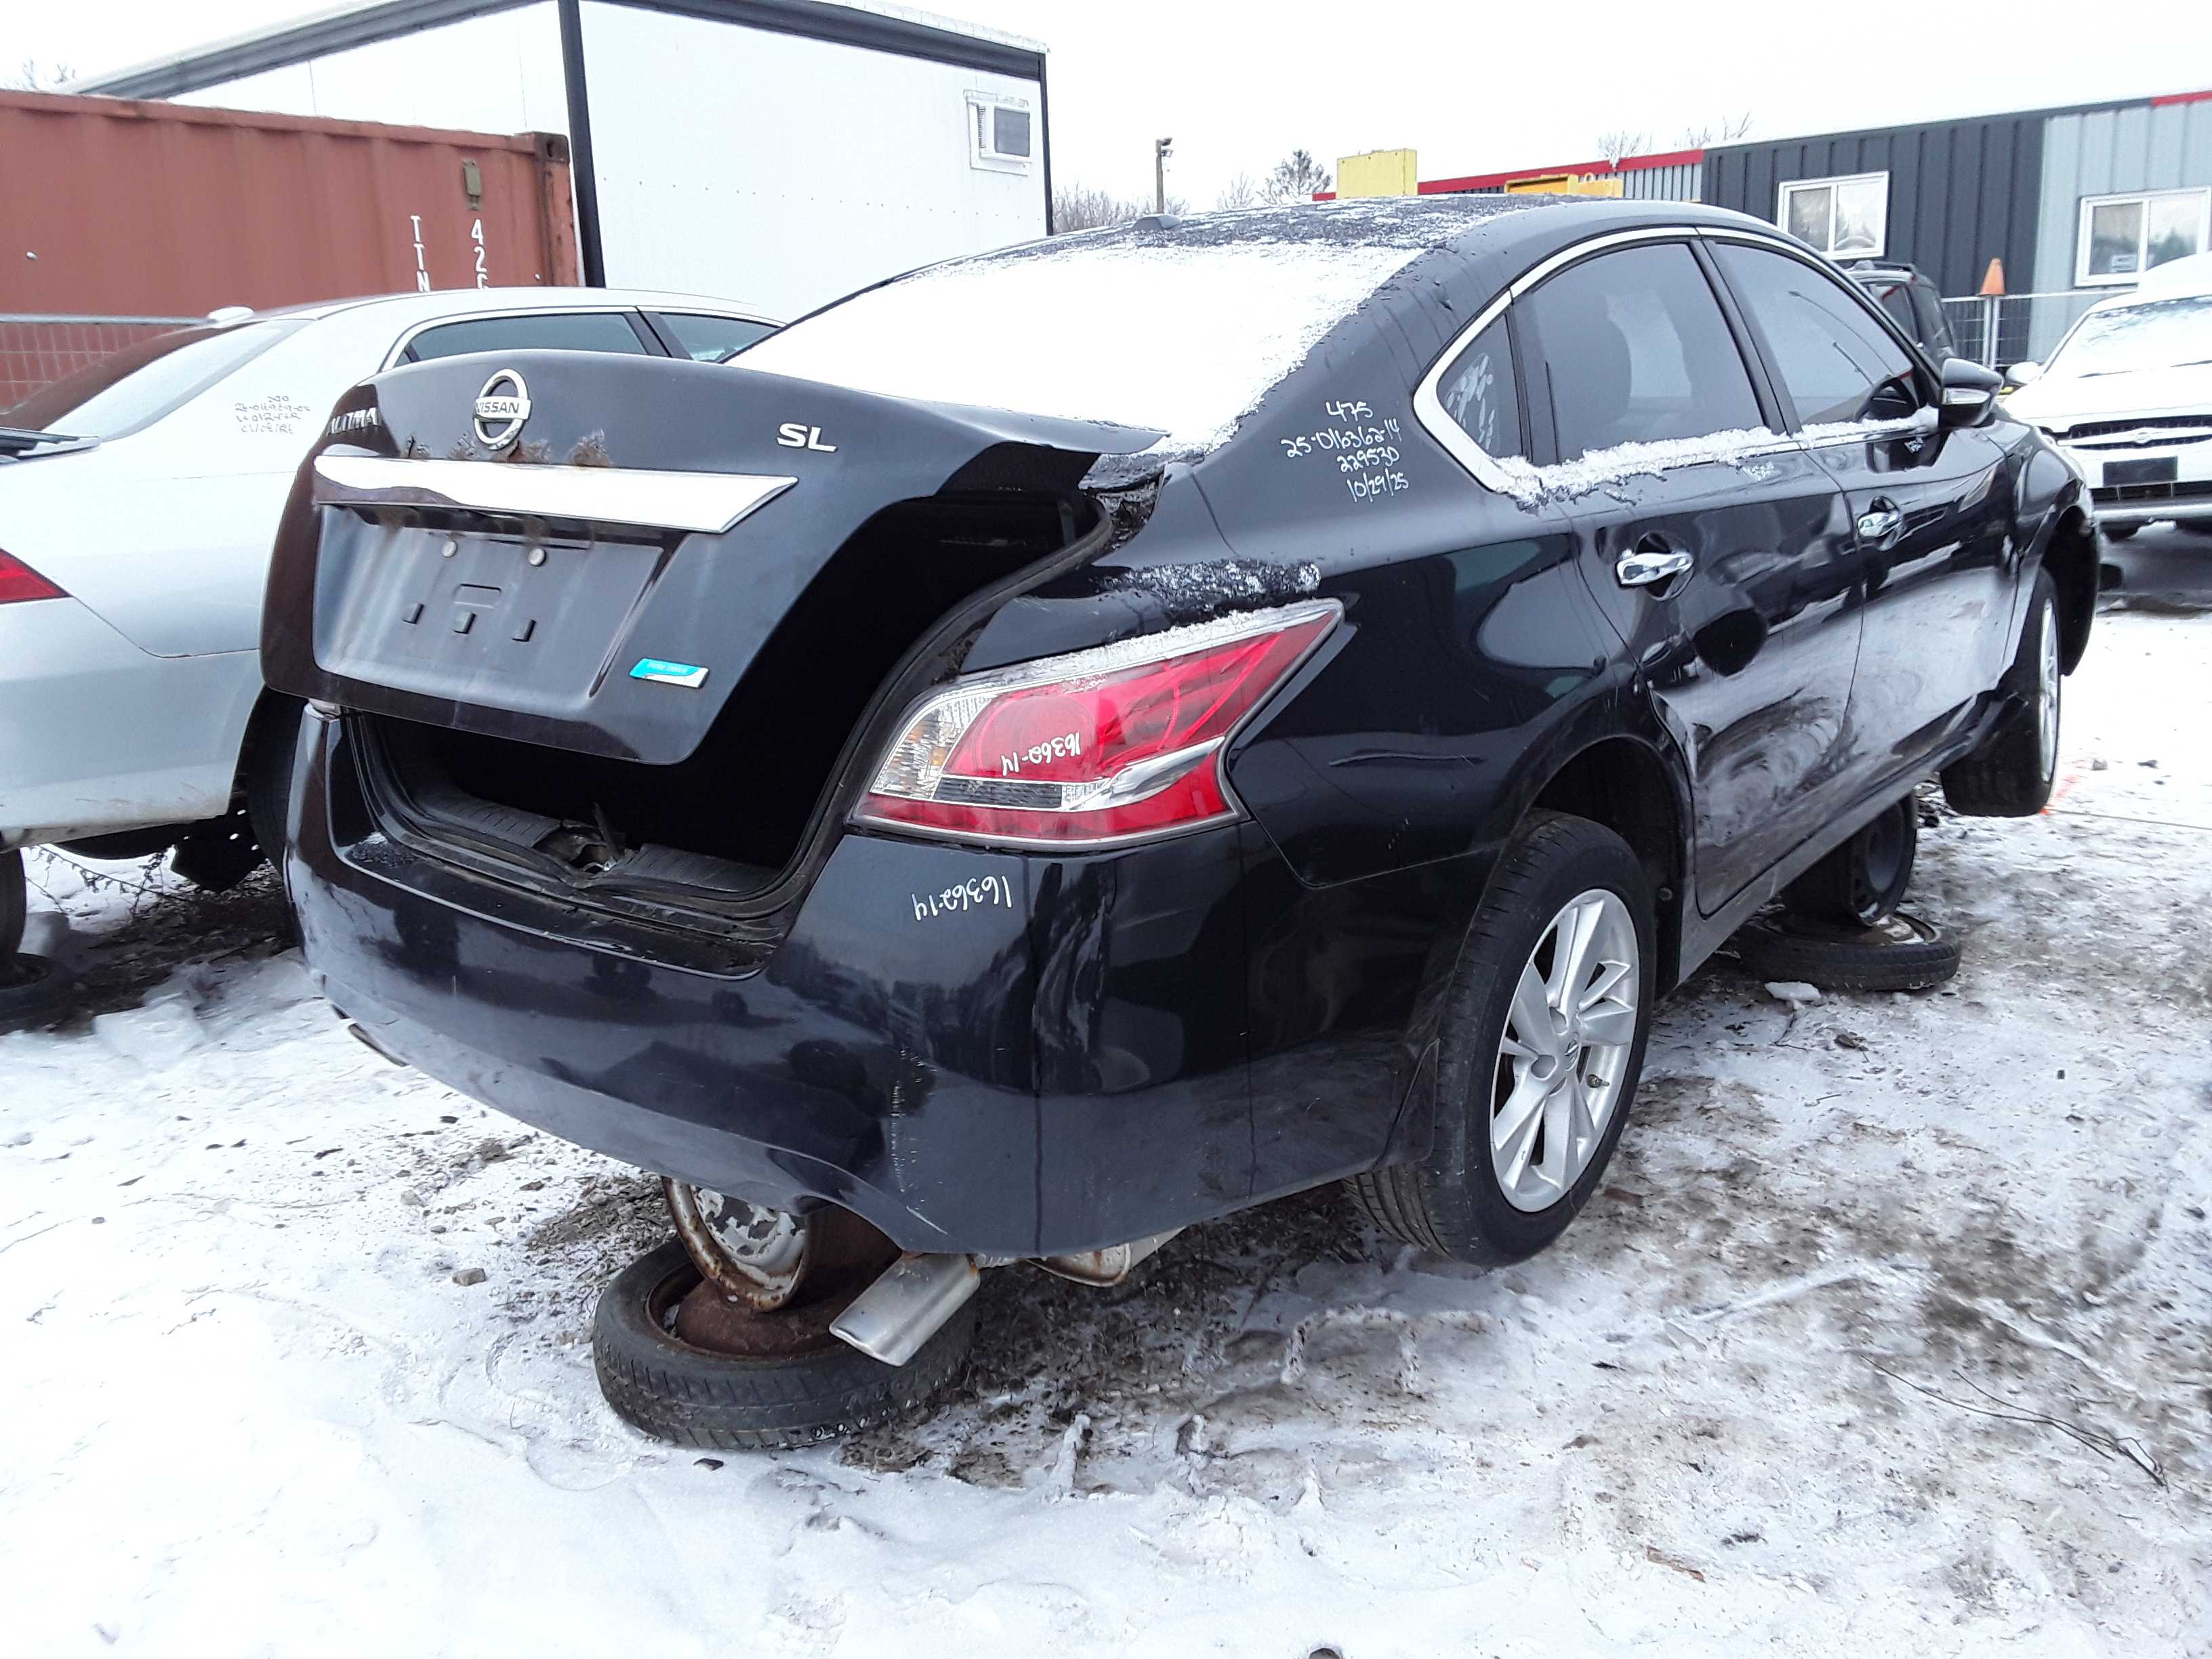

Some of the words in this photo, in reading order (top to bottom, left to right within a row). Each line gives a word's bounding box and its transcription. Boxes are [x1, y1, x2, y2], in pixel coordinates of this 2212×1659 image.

[476, 401, 520, 413] NISSAN
[1326, 401, 1374, 422] 475
[777, 423, 837, 453] SL
[1337, 446, 1399, 472] 229530
[1347, 468, 1409, 502] 10/29/25
